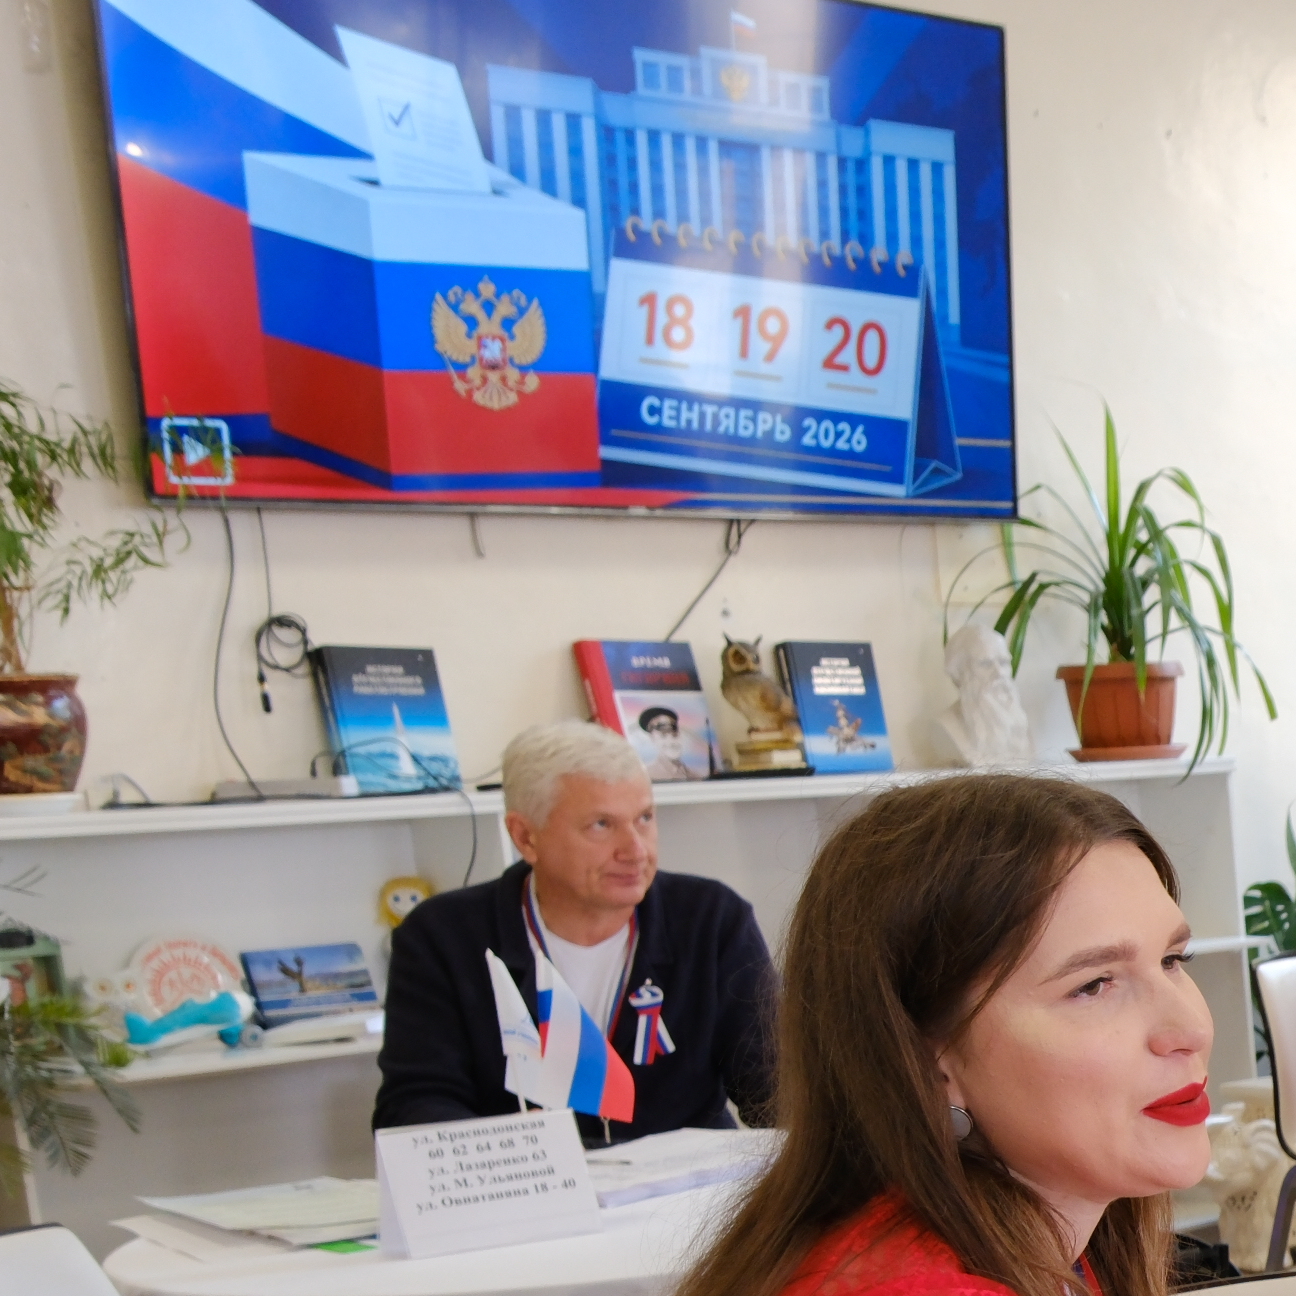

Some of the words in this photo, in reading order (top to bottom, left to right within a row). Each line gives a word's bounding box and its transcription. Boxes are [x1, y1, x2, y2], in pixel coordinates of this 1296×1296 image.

[637, 290, 695, 352] 18
[731, 303, 790, 364] 19
[821, 315, 888, 377] 20
[639, 395, 792, 443] СЕНТЯБРЬ
[801, 416, 868, 453] 2026
[452, 1144, 468, 1158] 62
[476, 1141, 491, 1154] 64
[523, 1134, 539, 1147] 70
[534, 1182, 549, 1195] 18
[561, 1177, 576, 1190] 40
